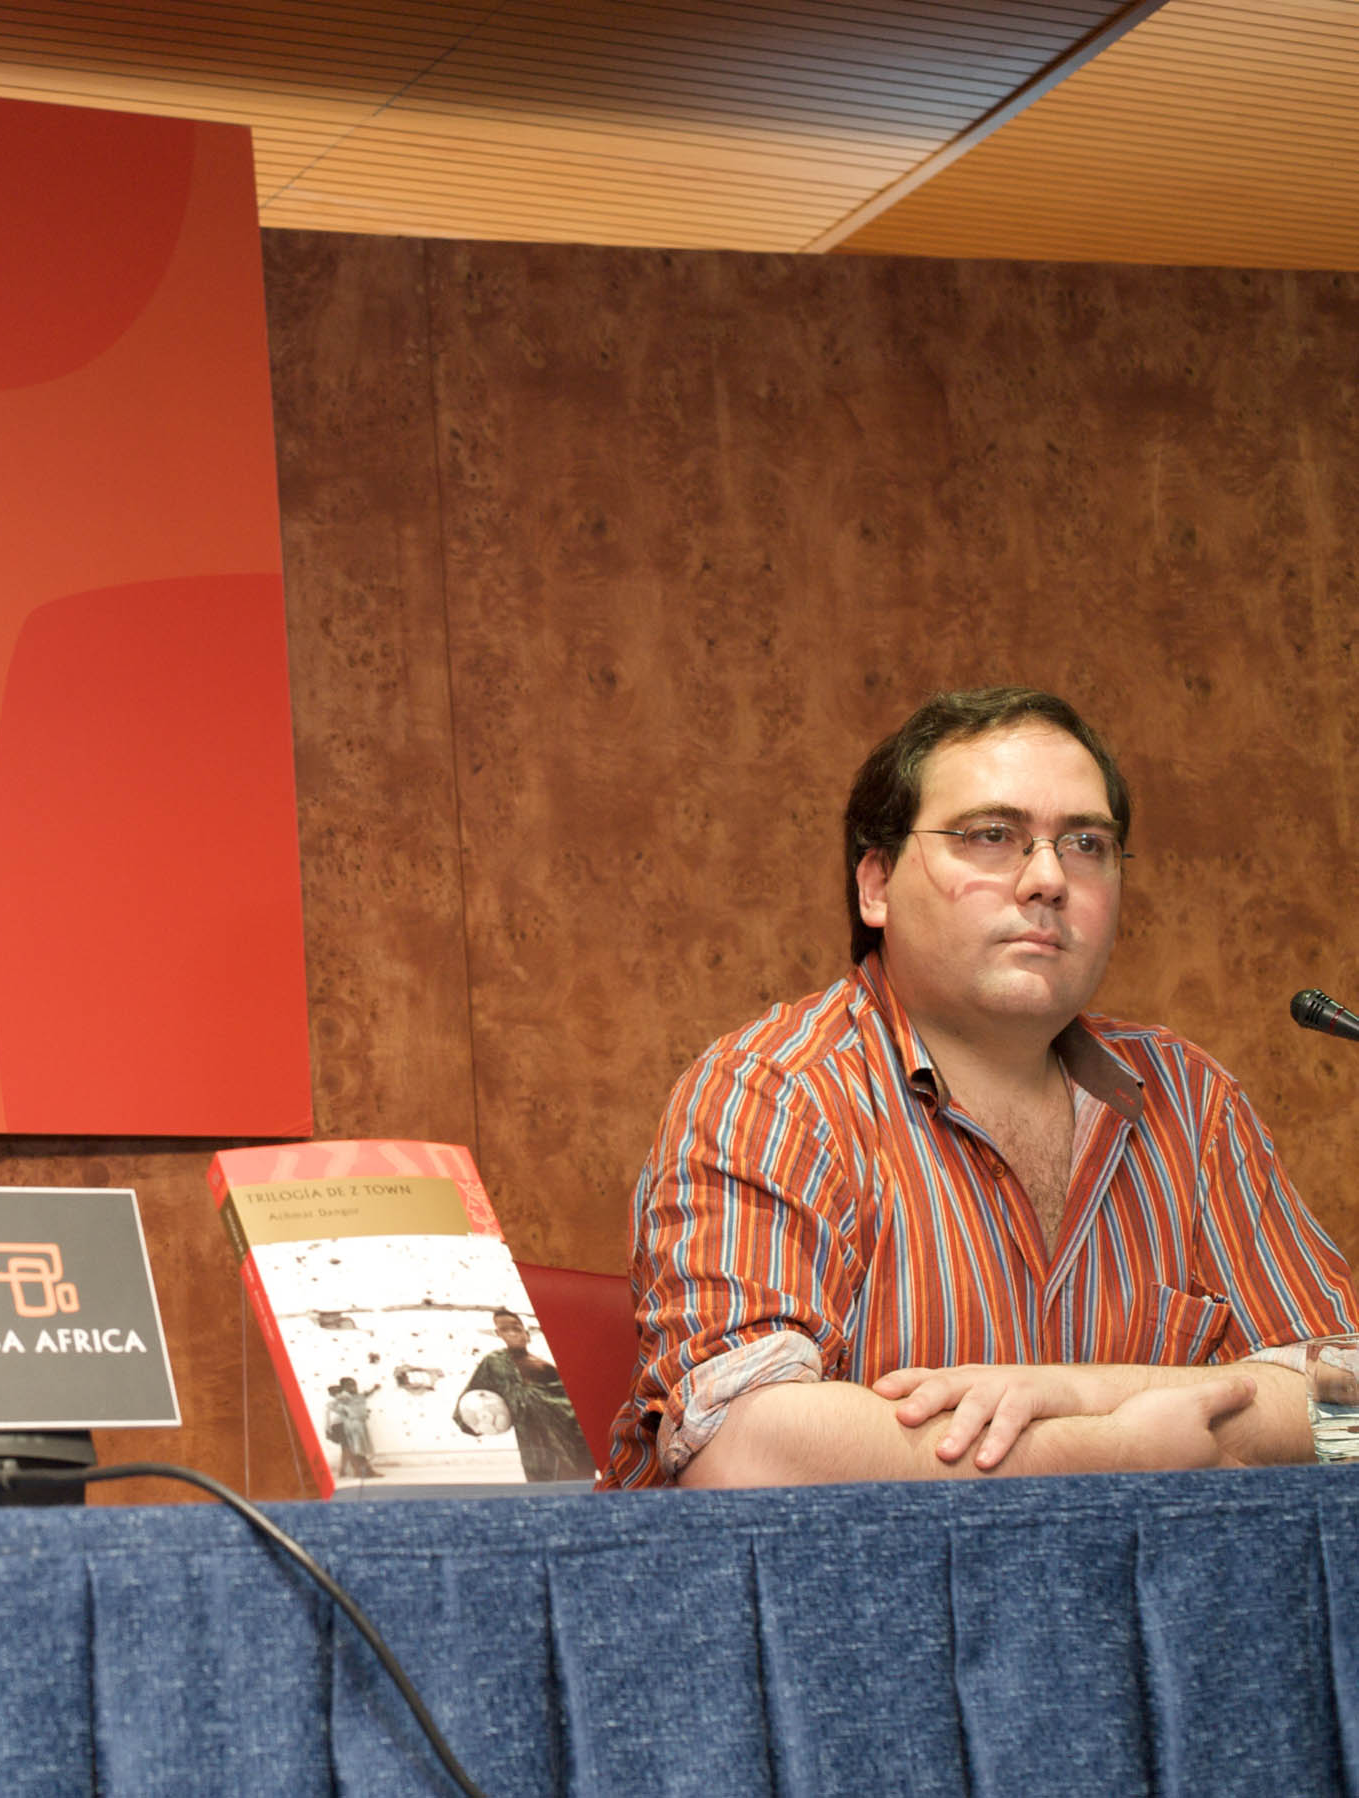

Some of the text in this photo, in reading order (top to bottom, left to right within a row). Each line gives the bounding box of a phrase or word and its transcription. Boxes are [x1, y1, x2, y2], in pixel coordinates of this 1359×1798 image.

[246, 1186, 323, 1204] TRILOGÍA
[326, 1186, 345, 1198] DE
[362, 1183, 411, 1195] TOWN
[35, 1328, 147, 1353] AFRICA
